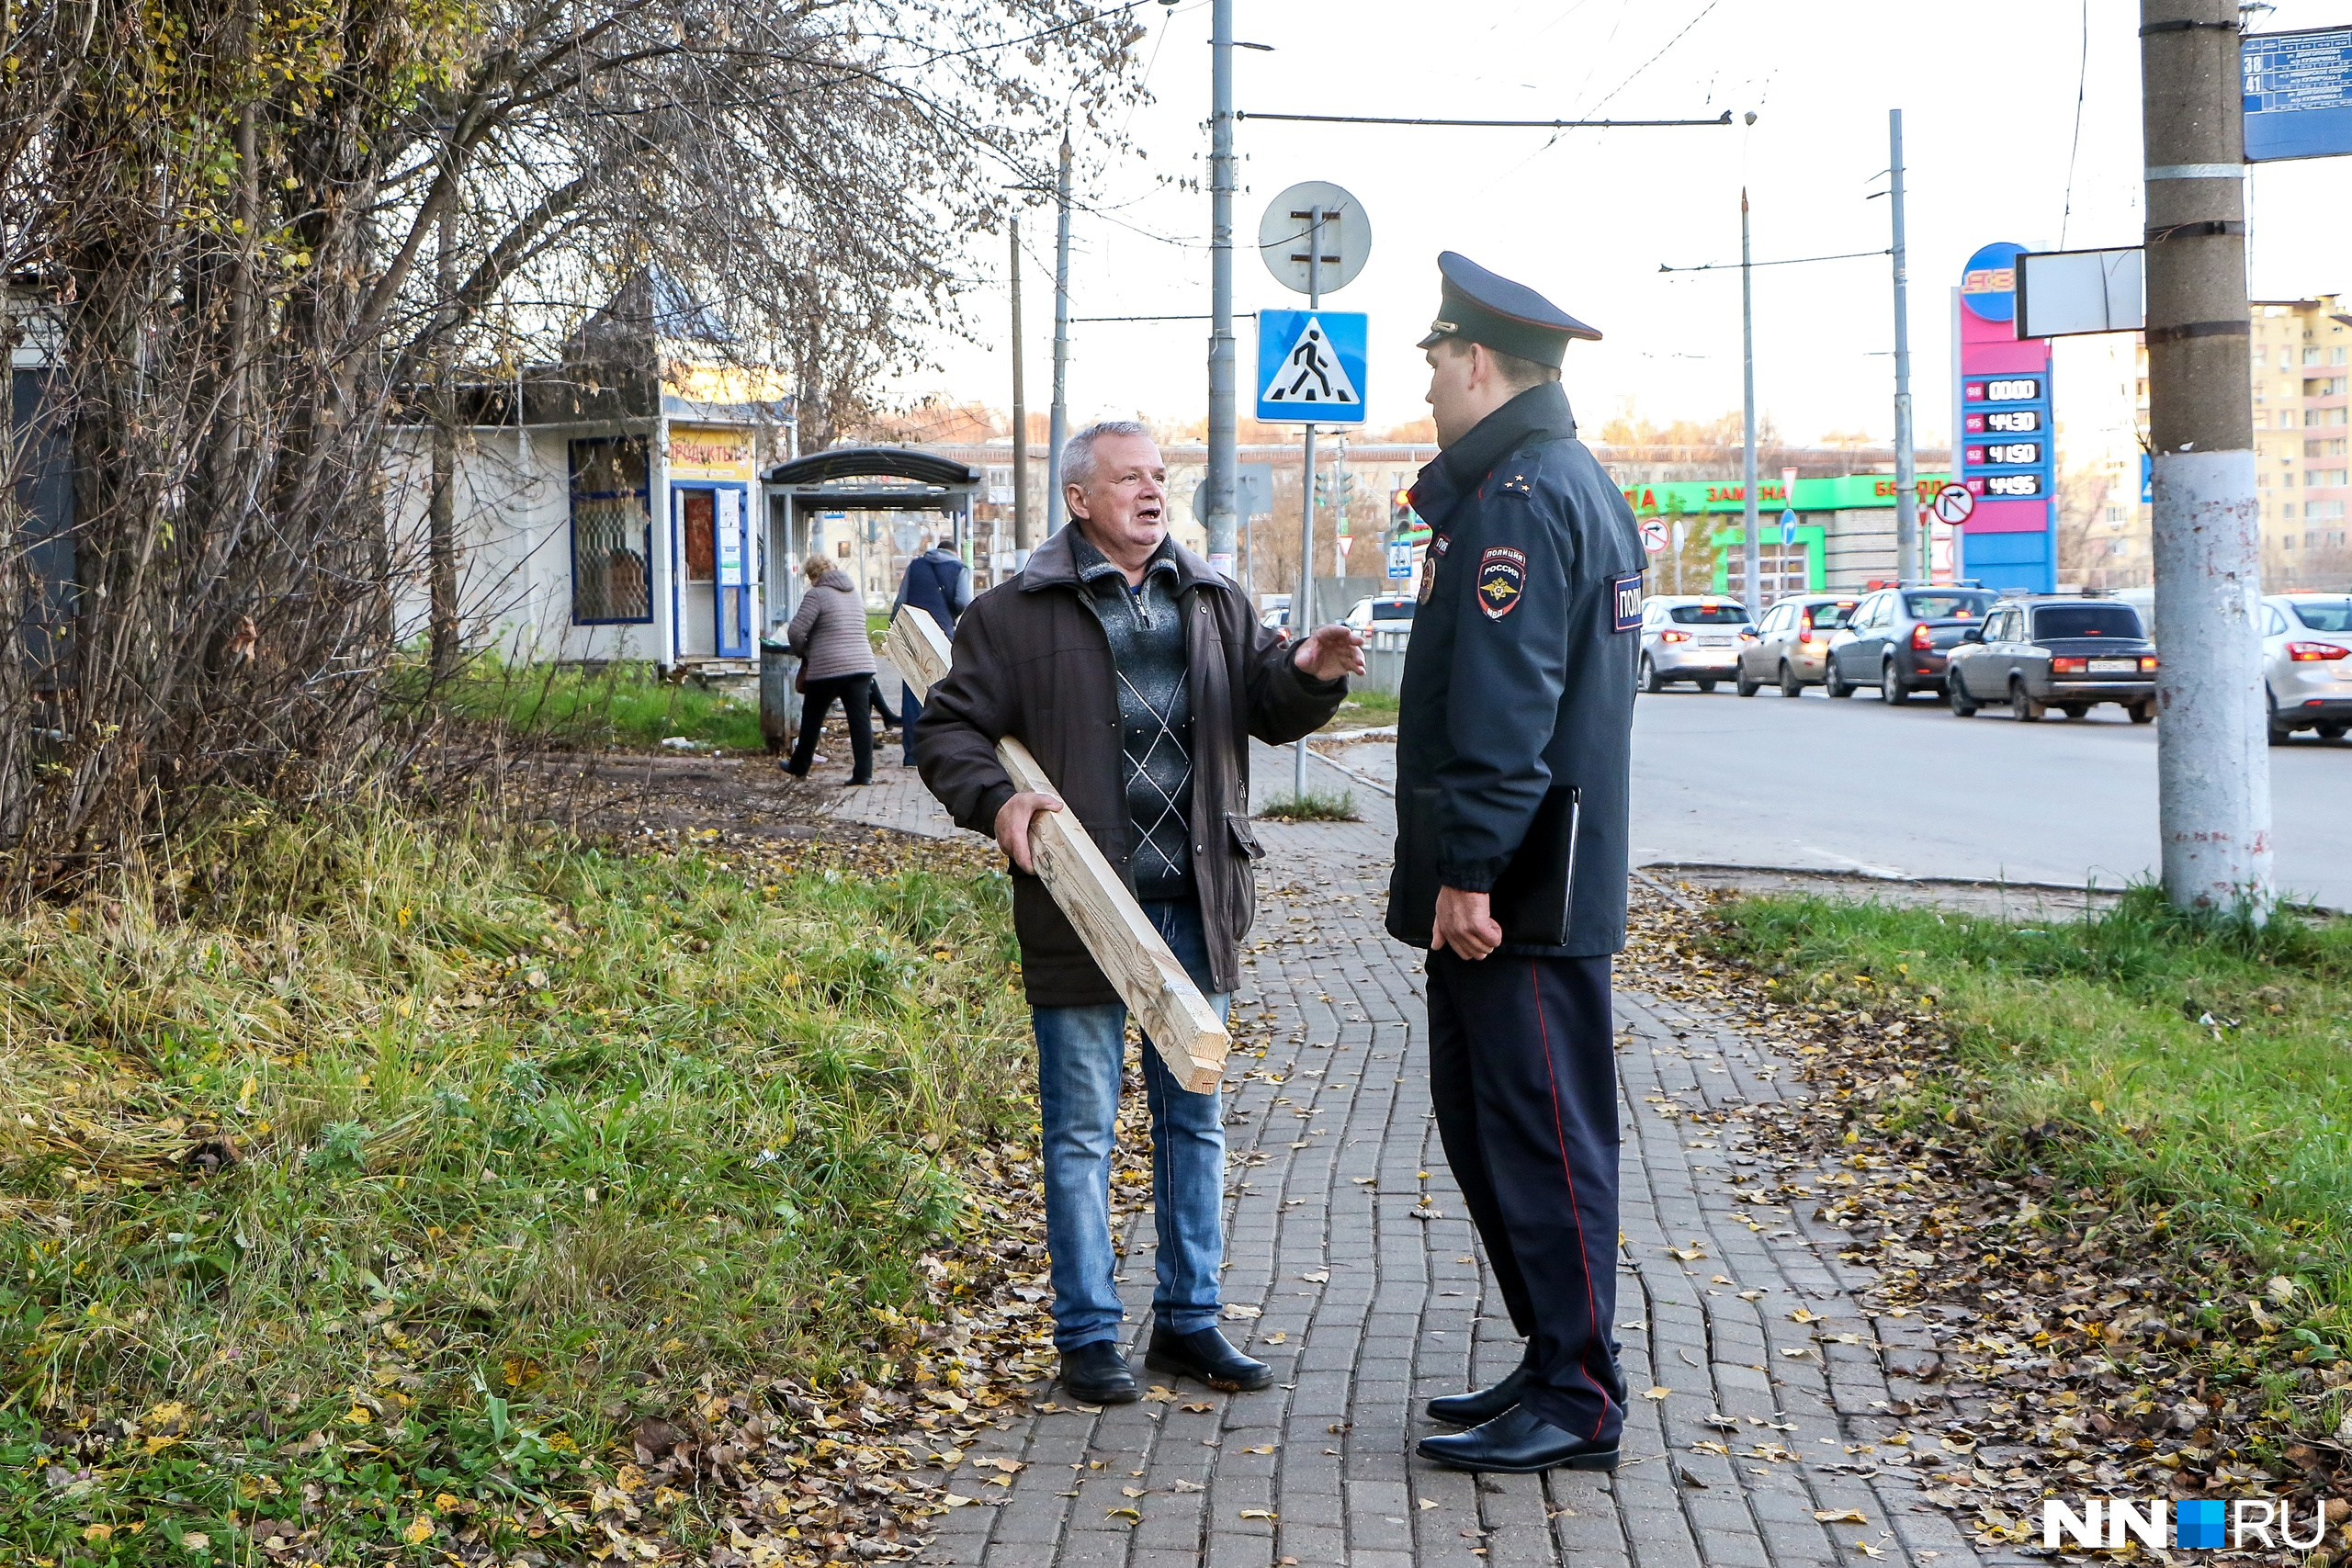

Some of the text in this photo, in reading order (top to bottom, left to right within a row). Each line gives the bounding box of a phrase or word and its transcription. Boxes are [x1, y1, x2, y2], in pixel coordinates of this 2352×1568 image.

[2244, 56, 2261, 73] 38
[2245, 75, 2261, 92] 41
[1966, 387, 1982, 397] 98
[1966, 418, 1982, 428] 95
[1966, 449, 1982, 459] 92
[1486, 549, 1523, 562] ПОЛИЦИЯ
[1484, 564, 1520, 580] РОССИЯ
[1487, 607, 1503, 620] МВД
